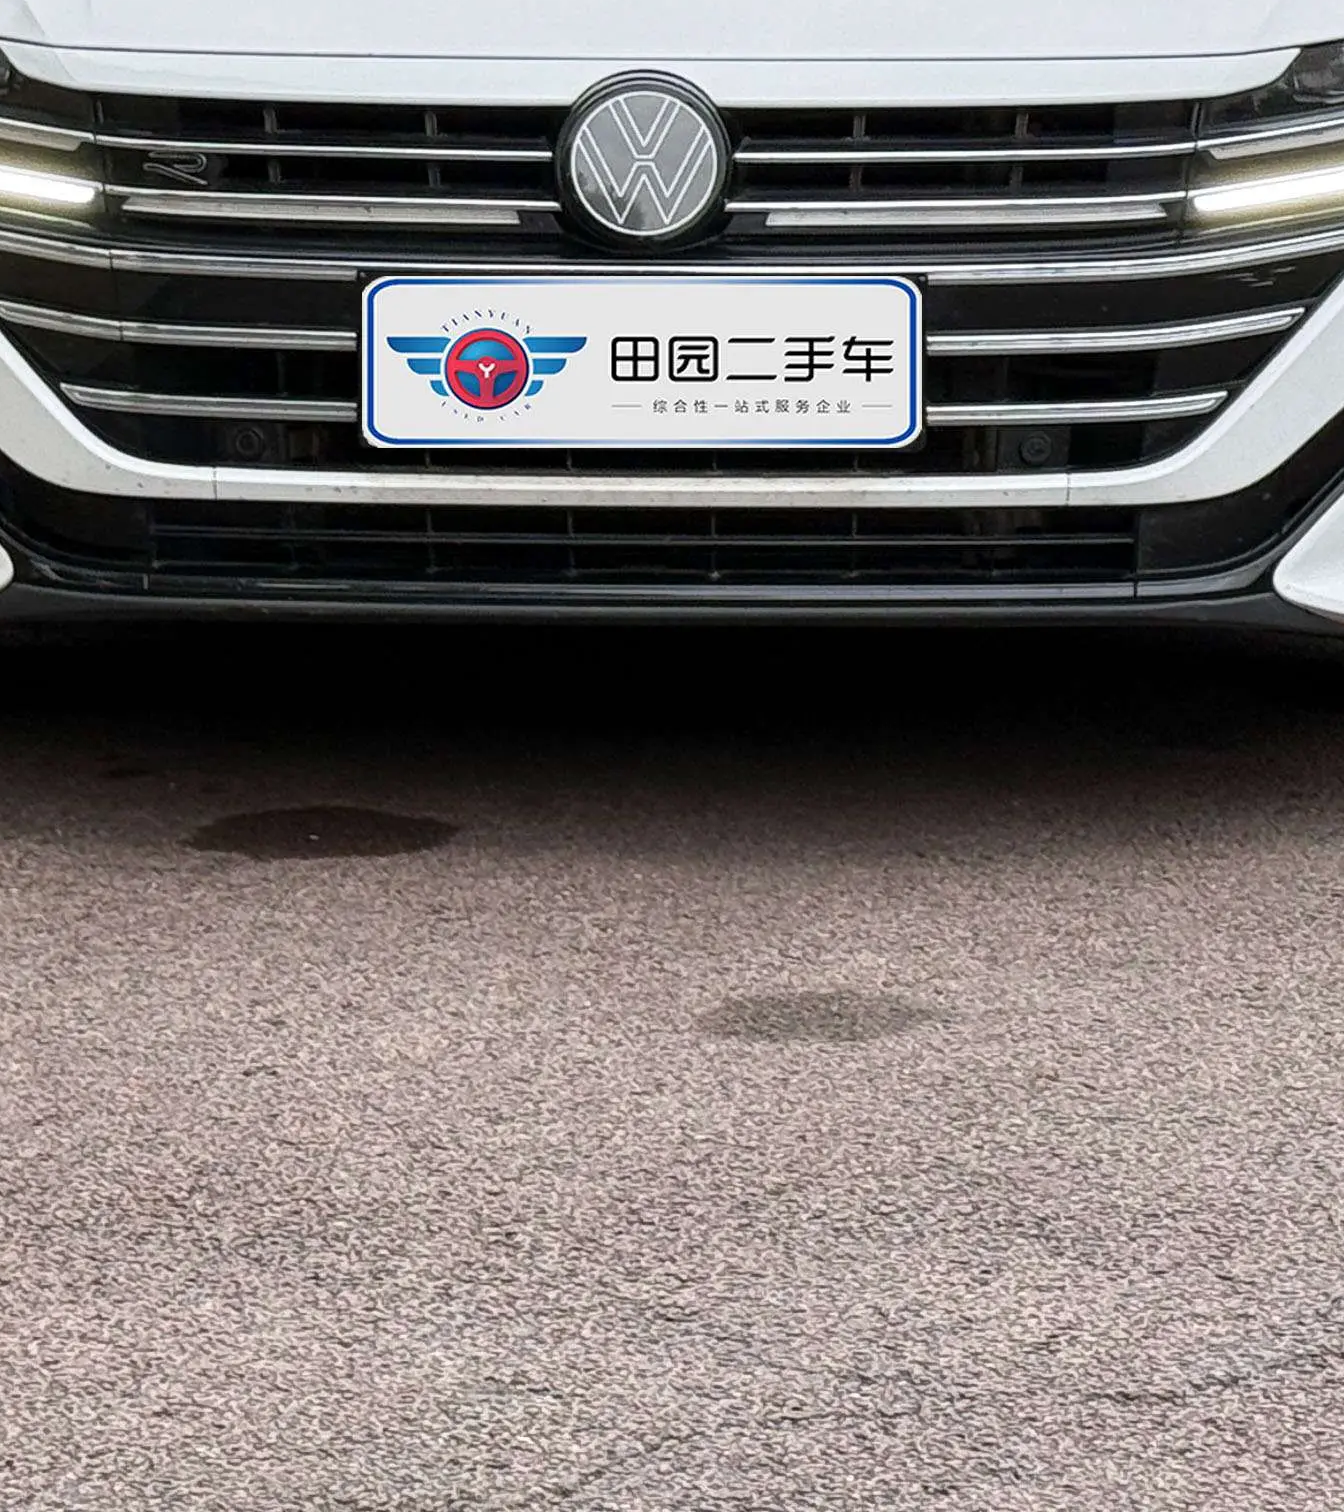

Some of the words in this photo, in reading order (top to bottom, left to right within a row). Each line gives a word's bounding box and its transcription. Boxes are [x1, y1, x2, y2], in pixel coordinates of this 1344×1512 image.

[611, 336, 895, 382] 田园二手车
[652, 399, 852, 414] 综合性一站式服务企业
